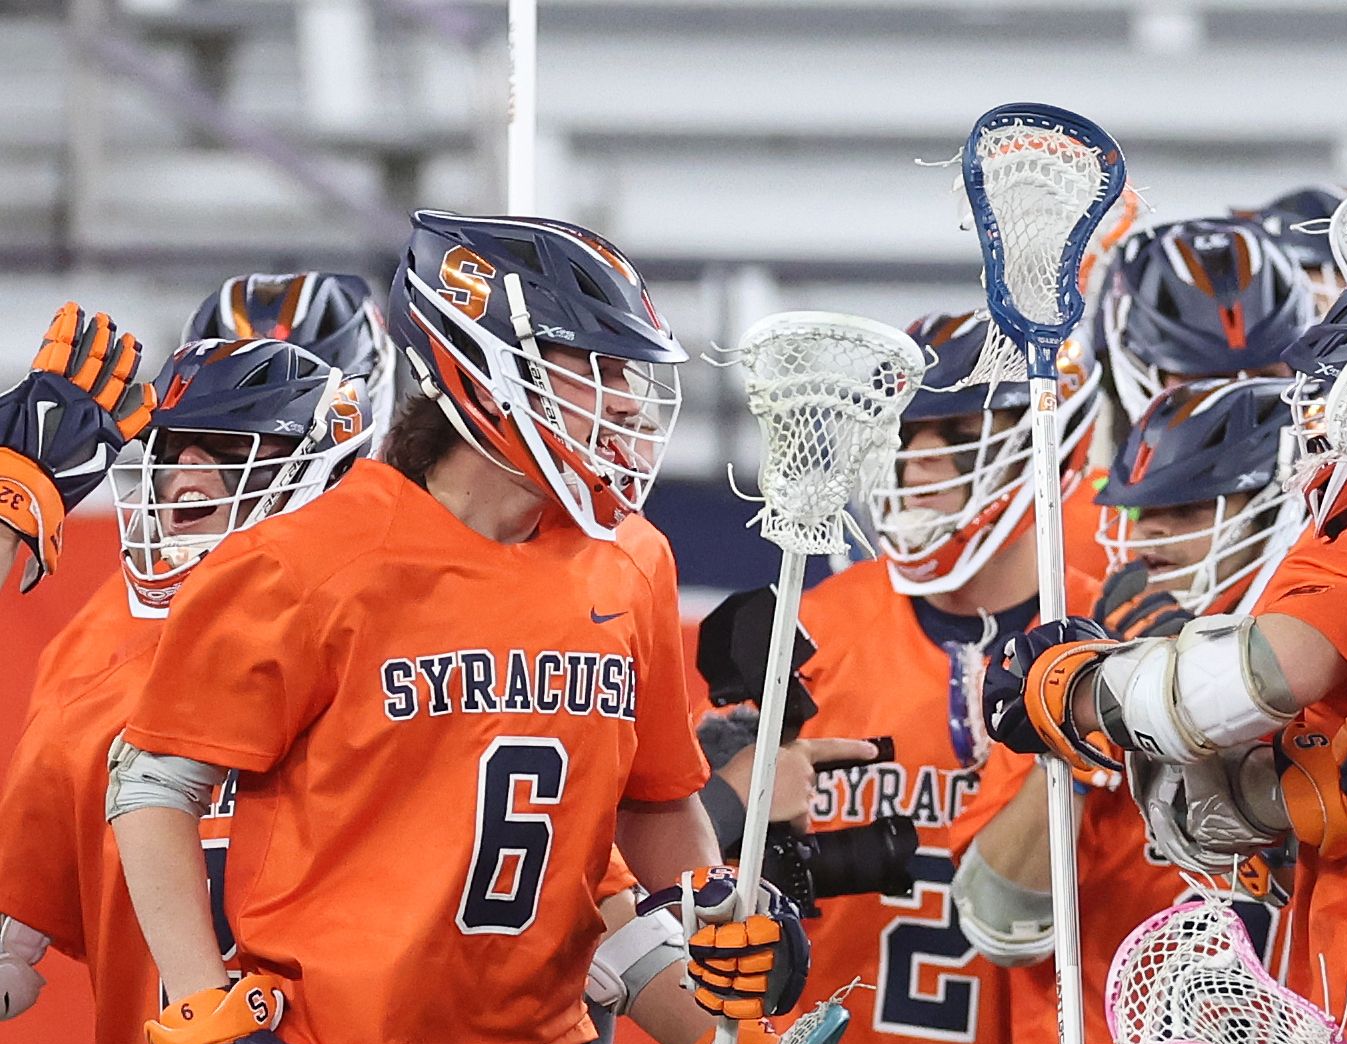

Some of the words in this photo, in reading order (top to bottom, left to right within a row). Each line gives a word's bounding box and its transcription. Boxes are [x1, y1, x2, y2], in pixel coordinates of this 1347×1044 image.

[434, 245, 497, 321] S
[455, 735, 570, 936] 6
[872, 845, 982, 1044] 2
[180, 1002, 195, 1022] 6
[246, 986, 270, 1026] S
